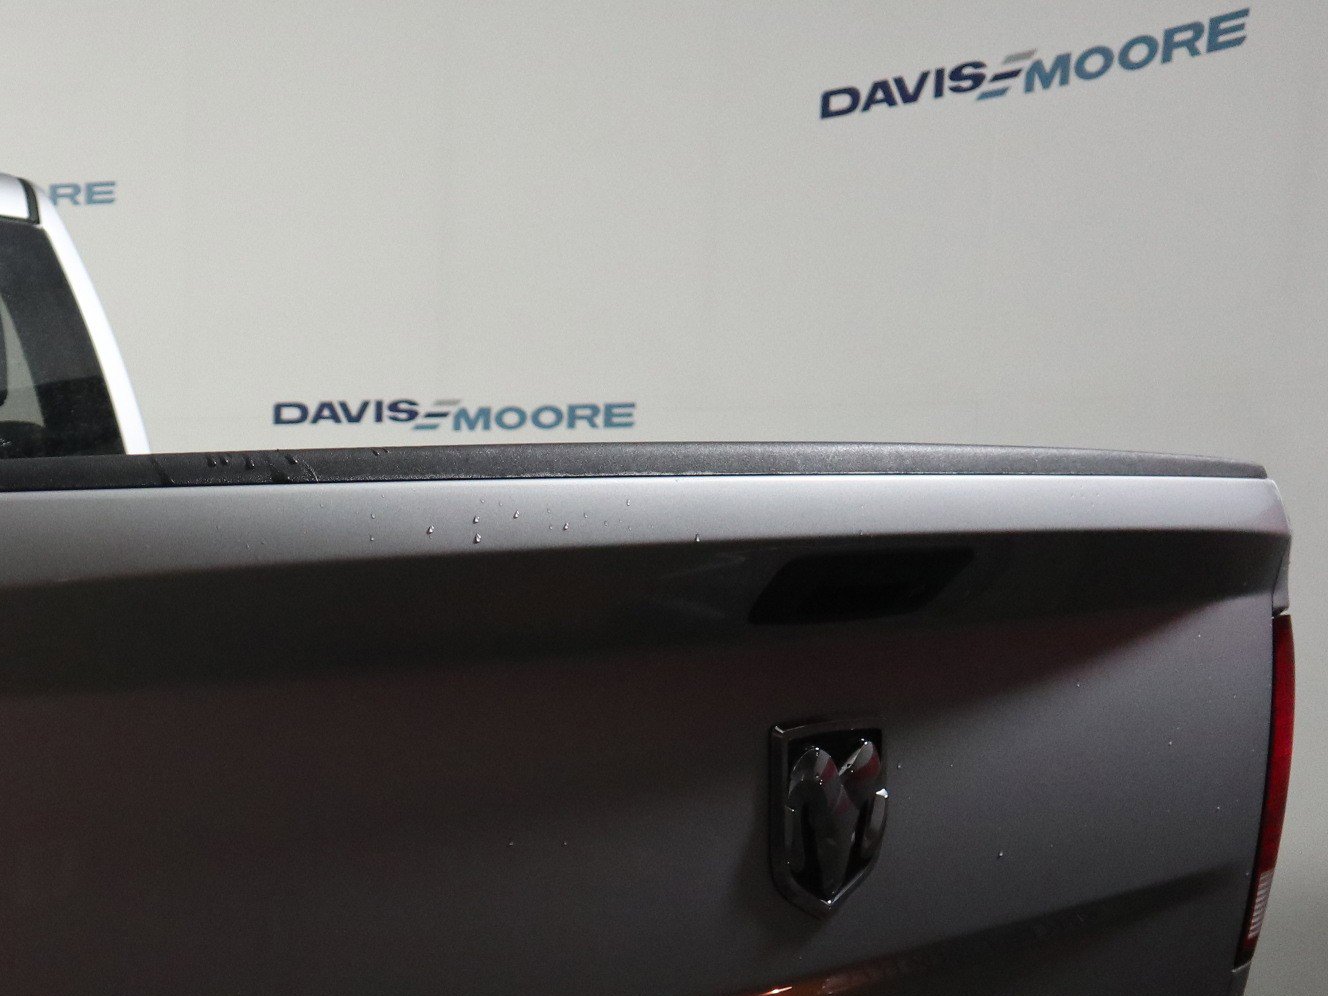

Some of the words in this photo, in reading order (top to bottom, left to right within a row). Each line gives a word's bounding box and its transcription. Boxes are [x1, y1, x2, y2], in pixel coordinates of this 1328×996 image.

[819, 60, 988, 119] DAVIS
[1023, 7, 1250, 94] MOORE
[273, 399, 418, 425] DAVIS
[452, 402, 636, 431] MOORE
